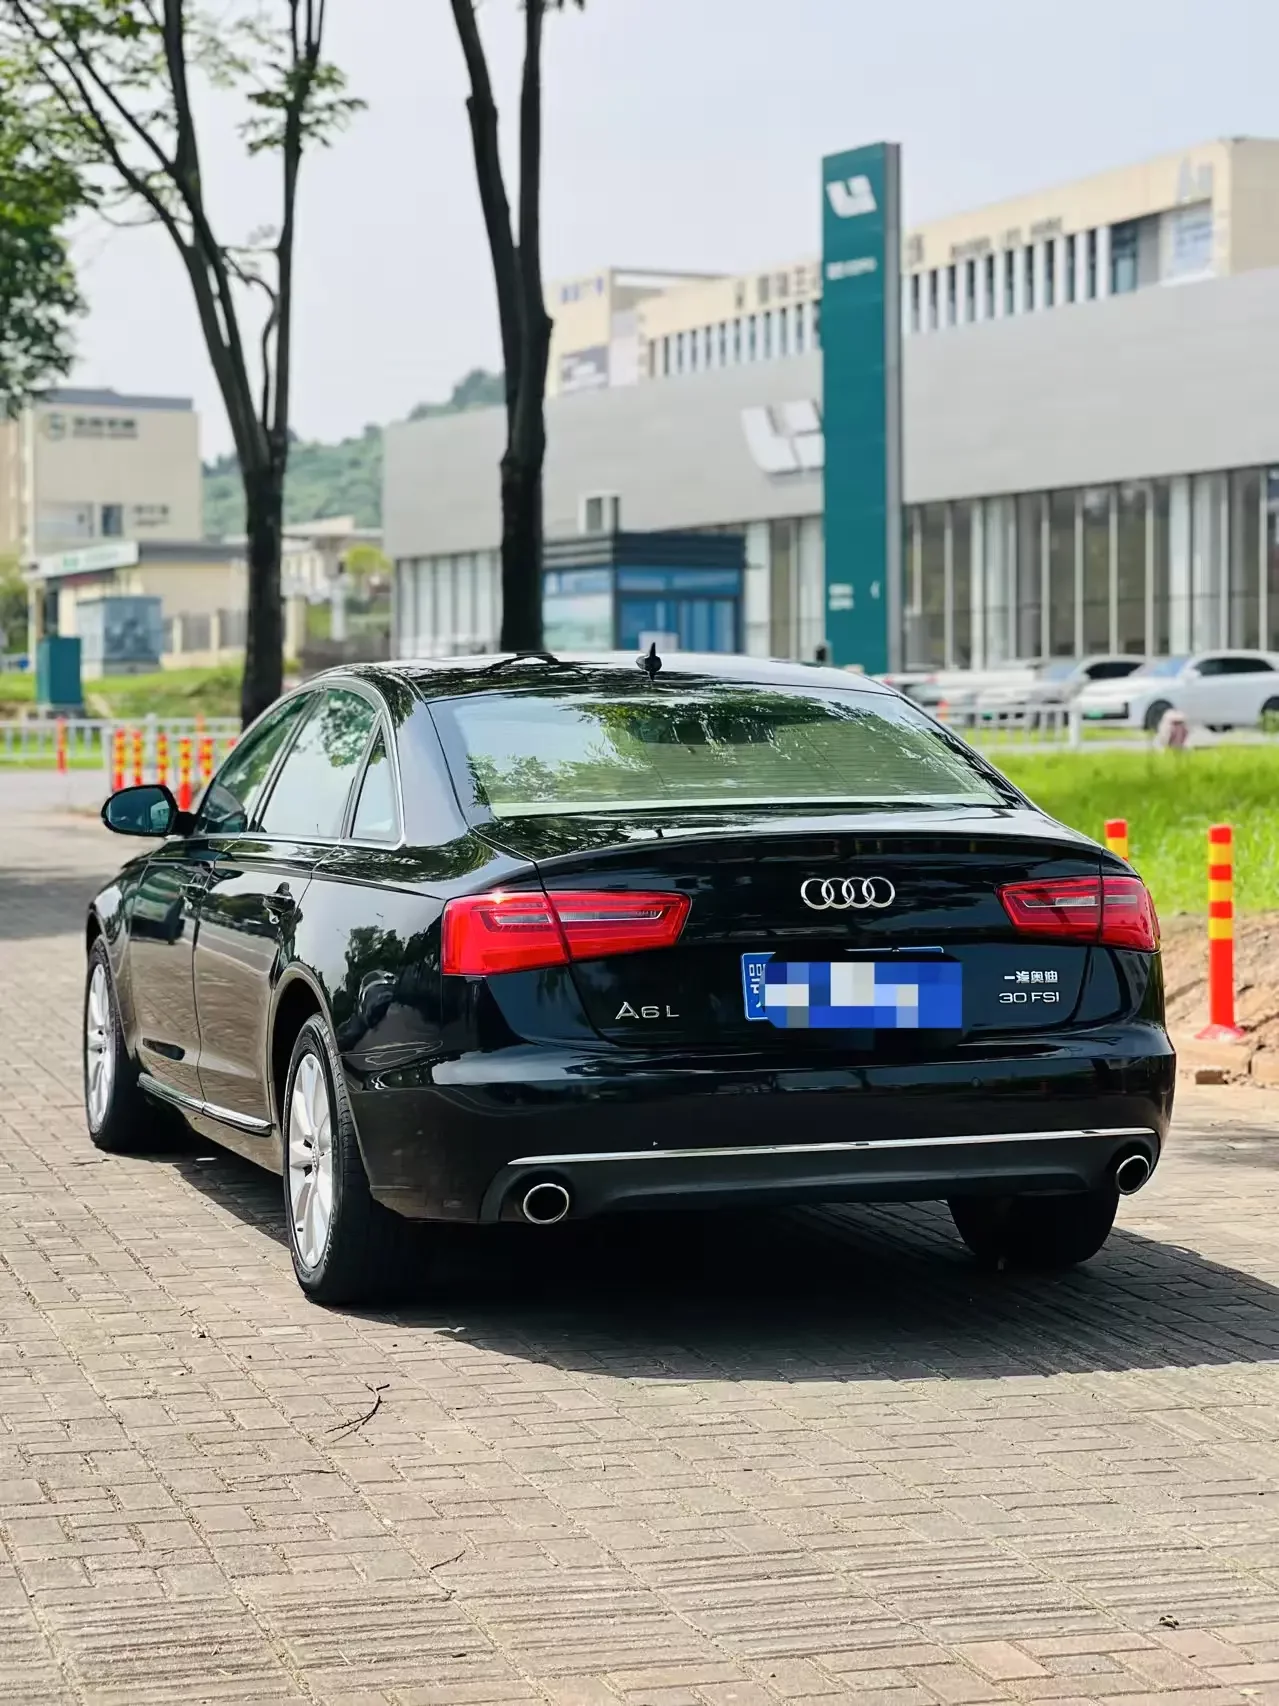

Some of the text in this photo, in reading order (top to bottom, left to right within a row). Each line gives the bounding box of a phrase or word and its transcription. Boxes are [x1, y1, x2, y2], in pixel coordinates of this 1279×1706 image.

[1003, 970, 1058, 984] 一汽奥迪
[998, 991, 1060, 1004] 30 FSI
